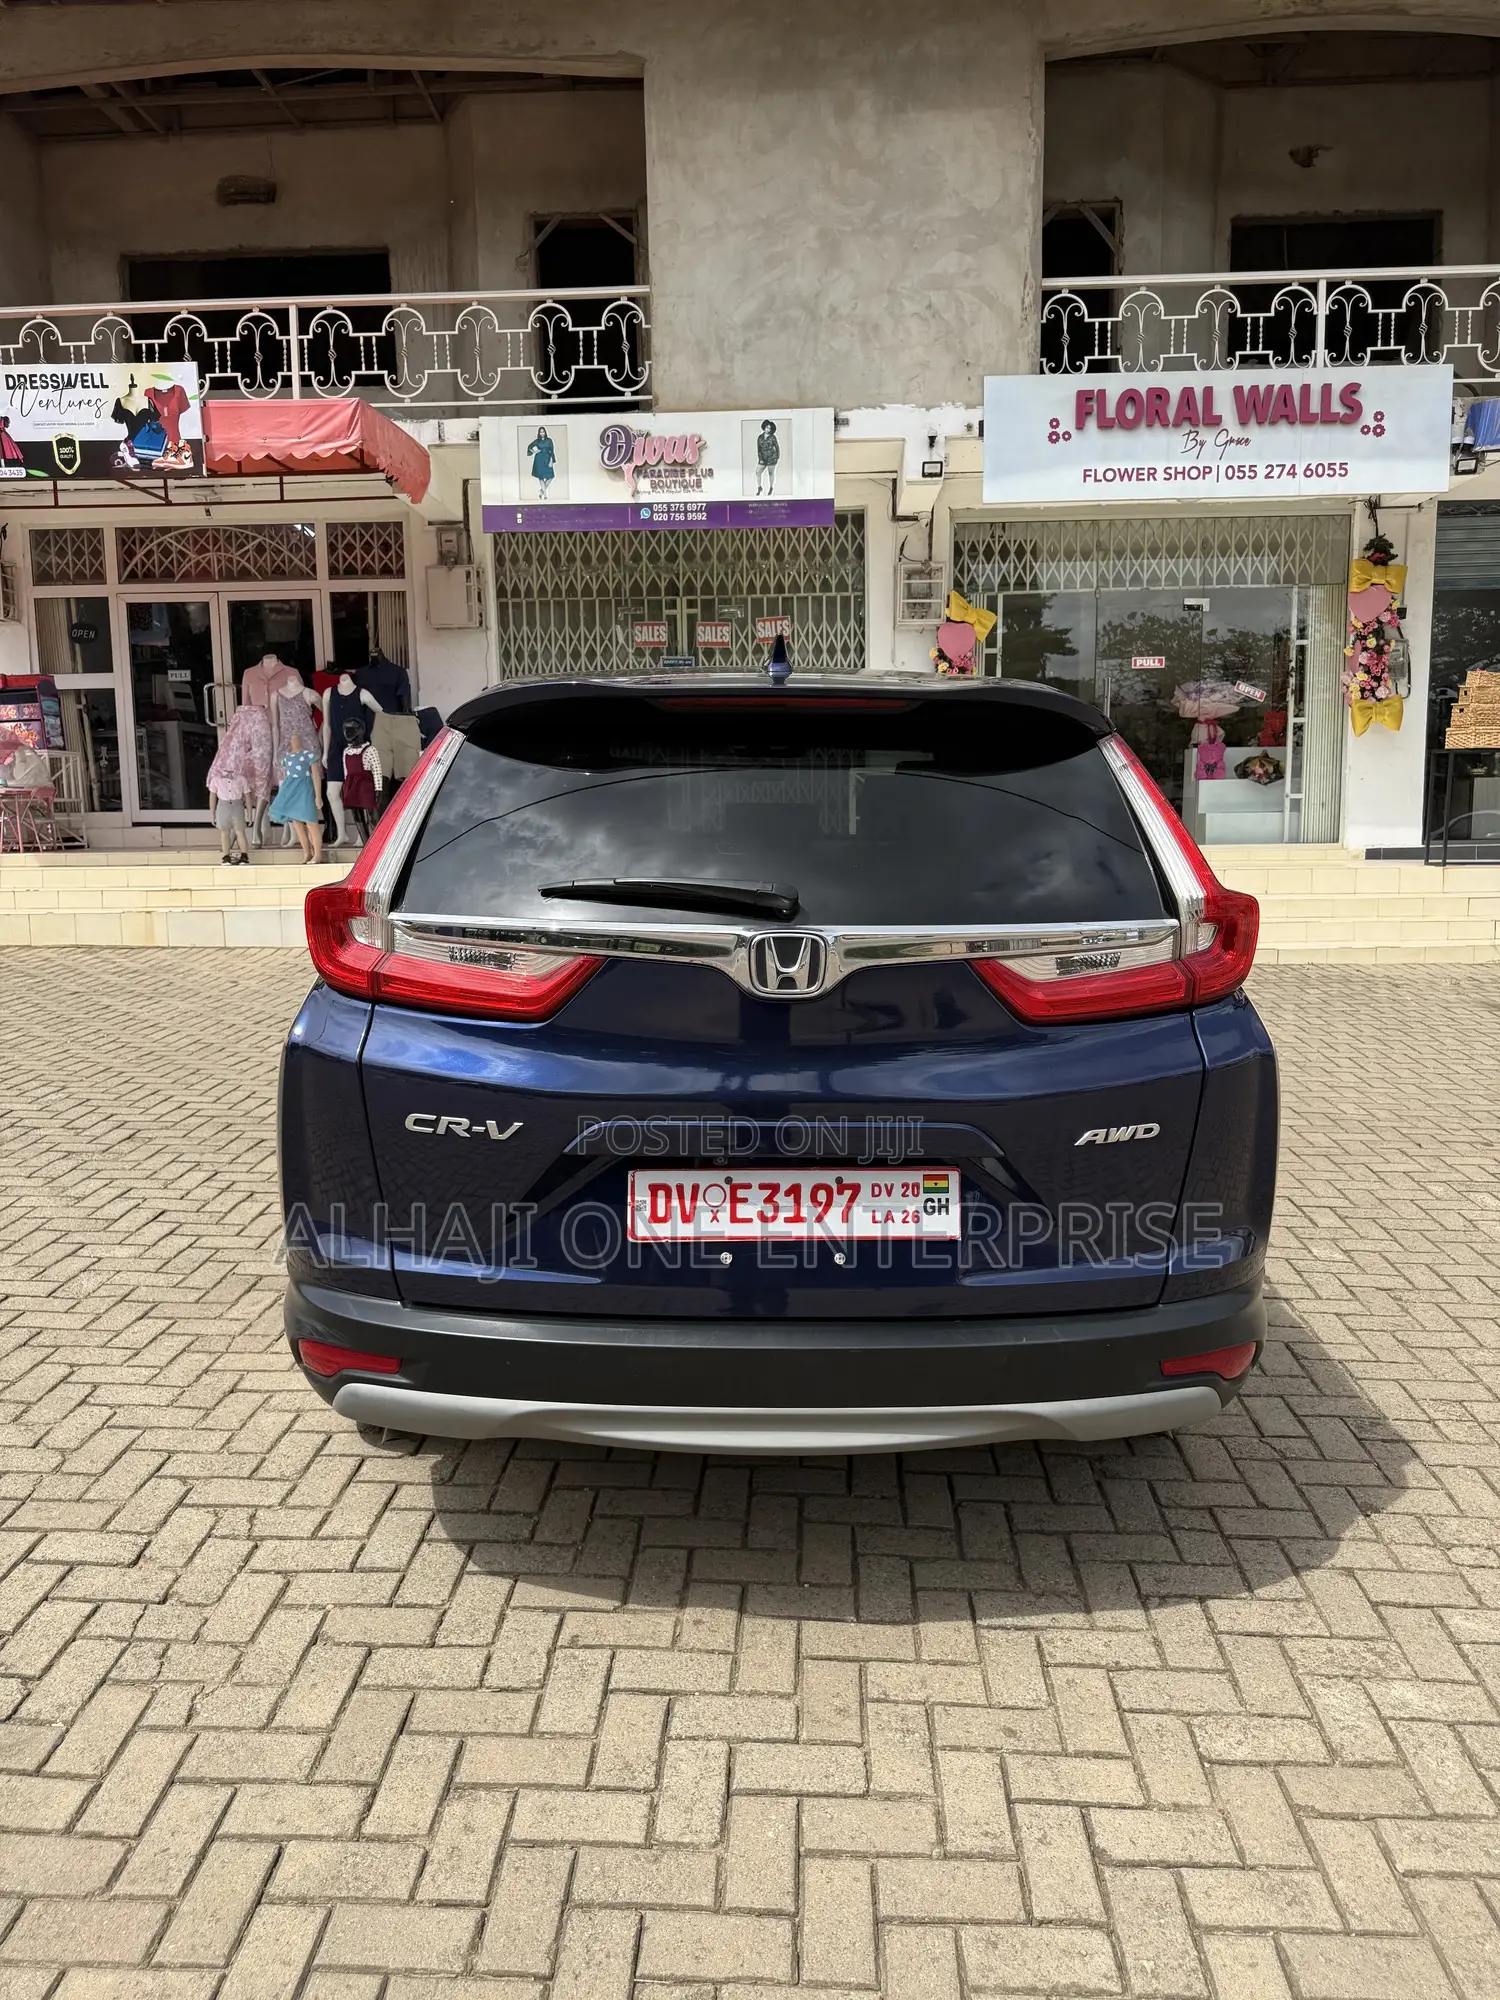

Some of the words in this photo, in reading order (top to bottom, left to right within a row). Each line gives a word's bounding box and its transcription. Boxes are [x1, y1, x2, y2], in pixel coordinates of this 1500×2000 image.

[4, 372, 109, 390] DRESSWELL
[10, 381, 108, 419] Ventures
[1075, 385, 1223, 430] FLORAL
[1232, 382, 1364, 425] WALLS
[599, 424, 707, 470] Divas
[1181, 429, 1207, 460] By
[636, 468, 686, 479] PARADISE
[688, 467, 714, 478] PLUS
[1082, 467, 1158, 483] FLOWER
[1162, 465, 1213, 481] SHOP
[1224, 464, 1258, 480] 055
[1264, 463, 1298, 480] 274
[1303, 462, 1349, 478] 6055
[650, 479, 702, 490] BOUTIQUE
[653, 504, 668, 512] 055
[687, 503, 707, 511] 6977
[653, 513, 668, 521] 020
[687, 512, 707, 520] 9592
[71, 629, 96, 639] OPEN
[634, 625, 667, 642] SALES
[697, 626, 730, 642] SALES
[758, 619, 790, 638] SALES
[1136, 657, 1161, 667] PULL
[1239, 684, 1262, 698] OPEN
[404, 1112, 524, 1140] CR-V
[1074, 1122, 1161, 1146] AWD
[871, 1182, 895, 1198] DV
[901, 1181, 921, 1198] 20
[648, 1183, 701, 1224] DV
[729, 1182, 862, 1224] E3197
[923, 1197, 950, 1216] GH
[871, 1210, 895, 1224] LA
[901, 1209, 921, 1224] 26
